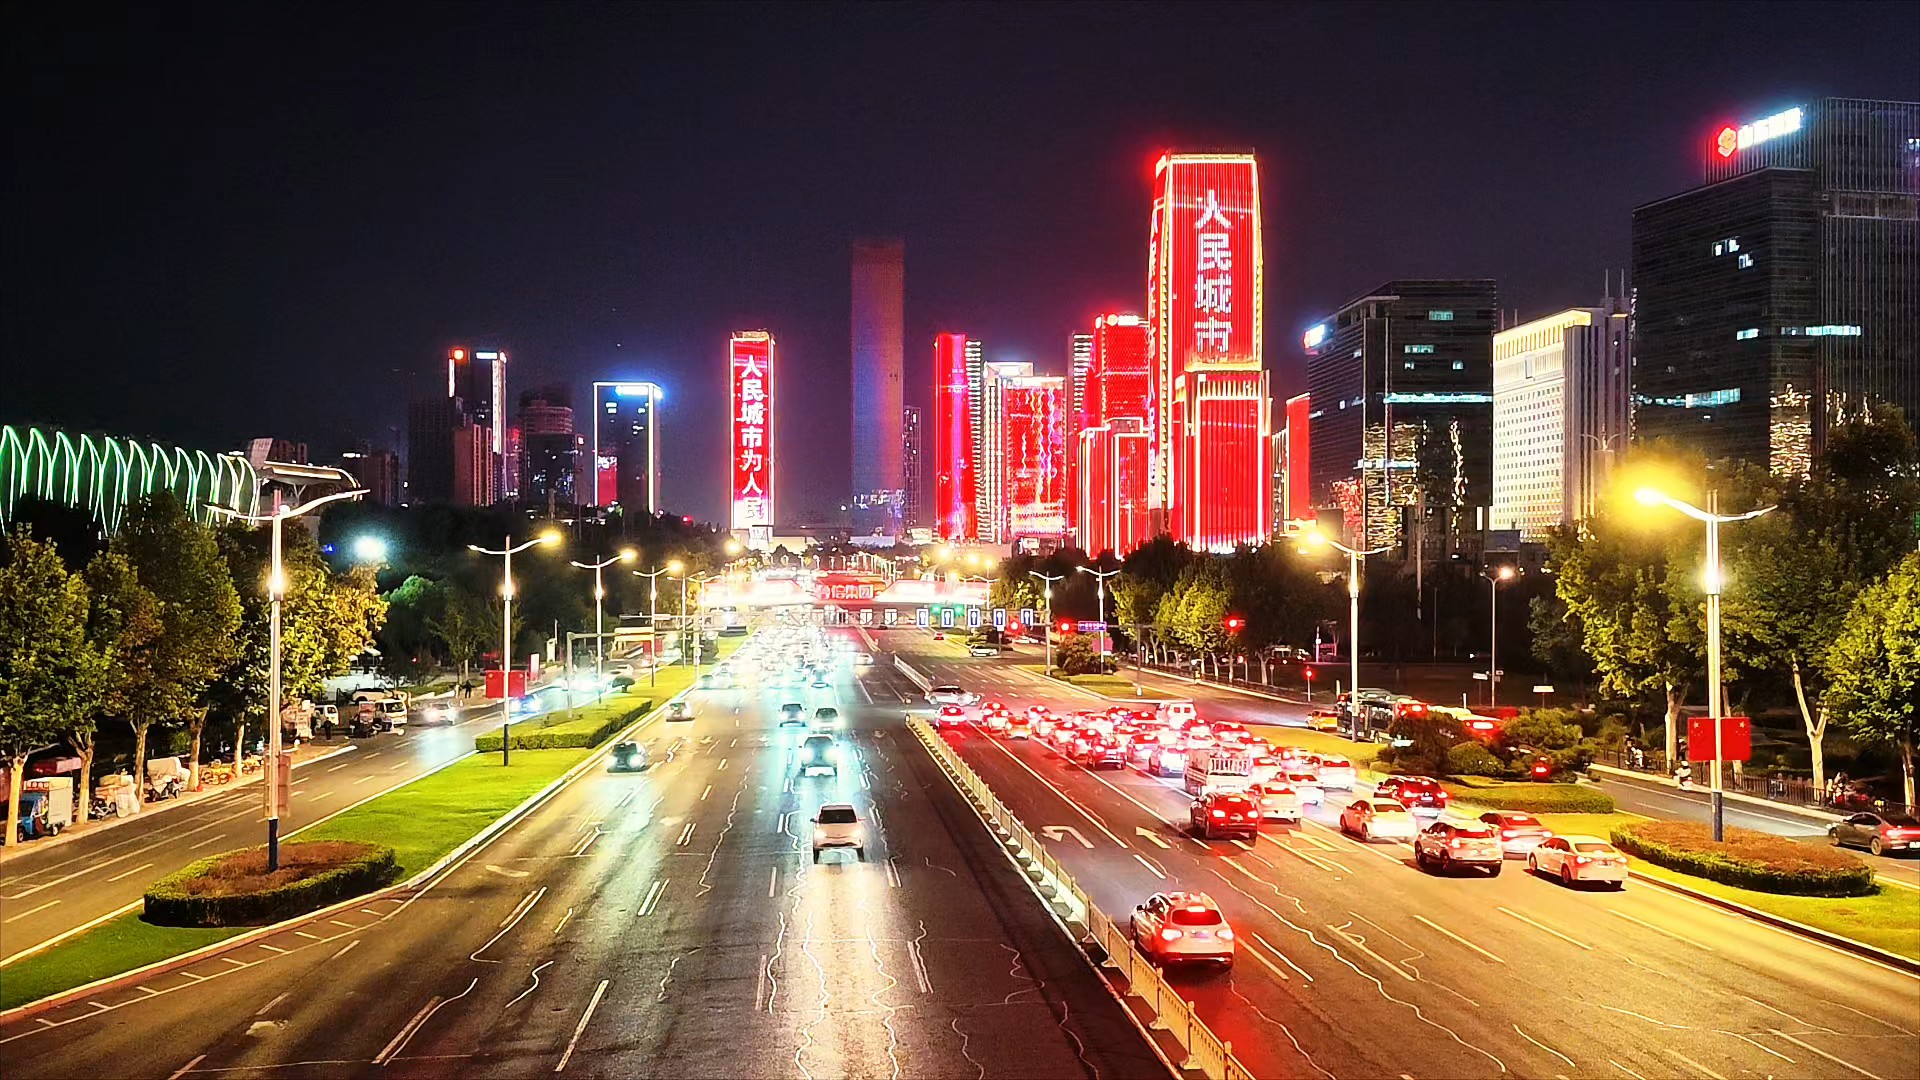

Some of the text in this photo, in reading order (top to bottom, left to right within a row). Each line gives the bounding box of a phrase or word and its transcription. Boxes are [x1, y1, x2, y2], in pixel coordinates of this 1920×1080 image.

[1194, 189, 1232, 353] 人民城市
[740, 354, 764, 520] 人民城市为人民
